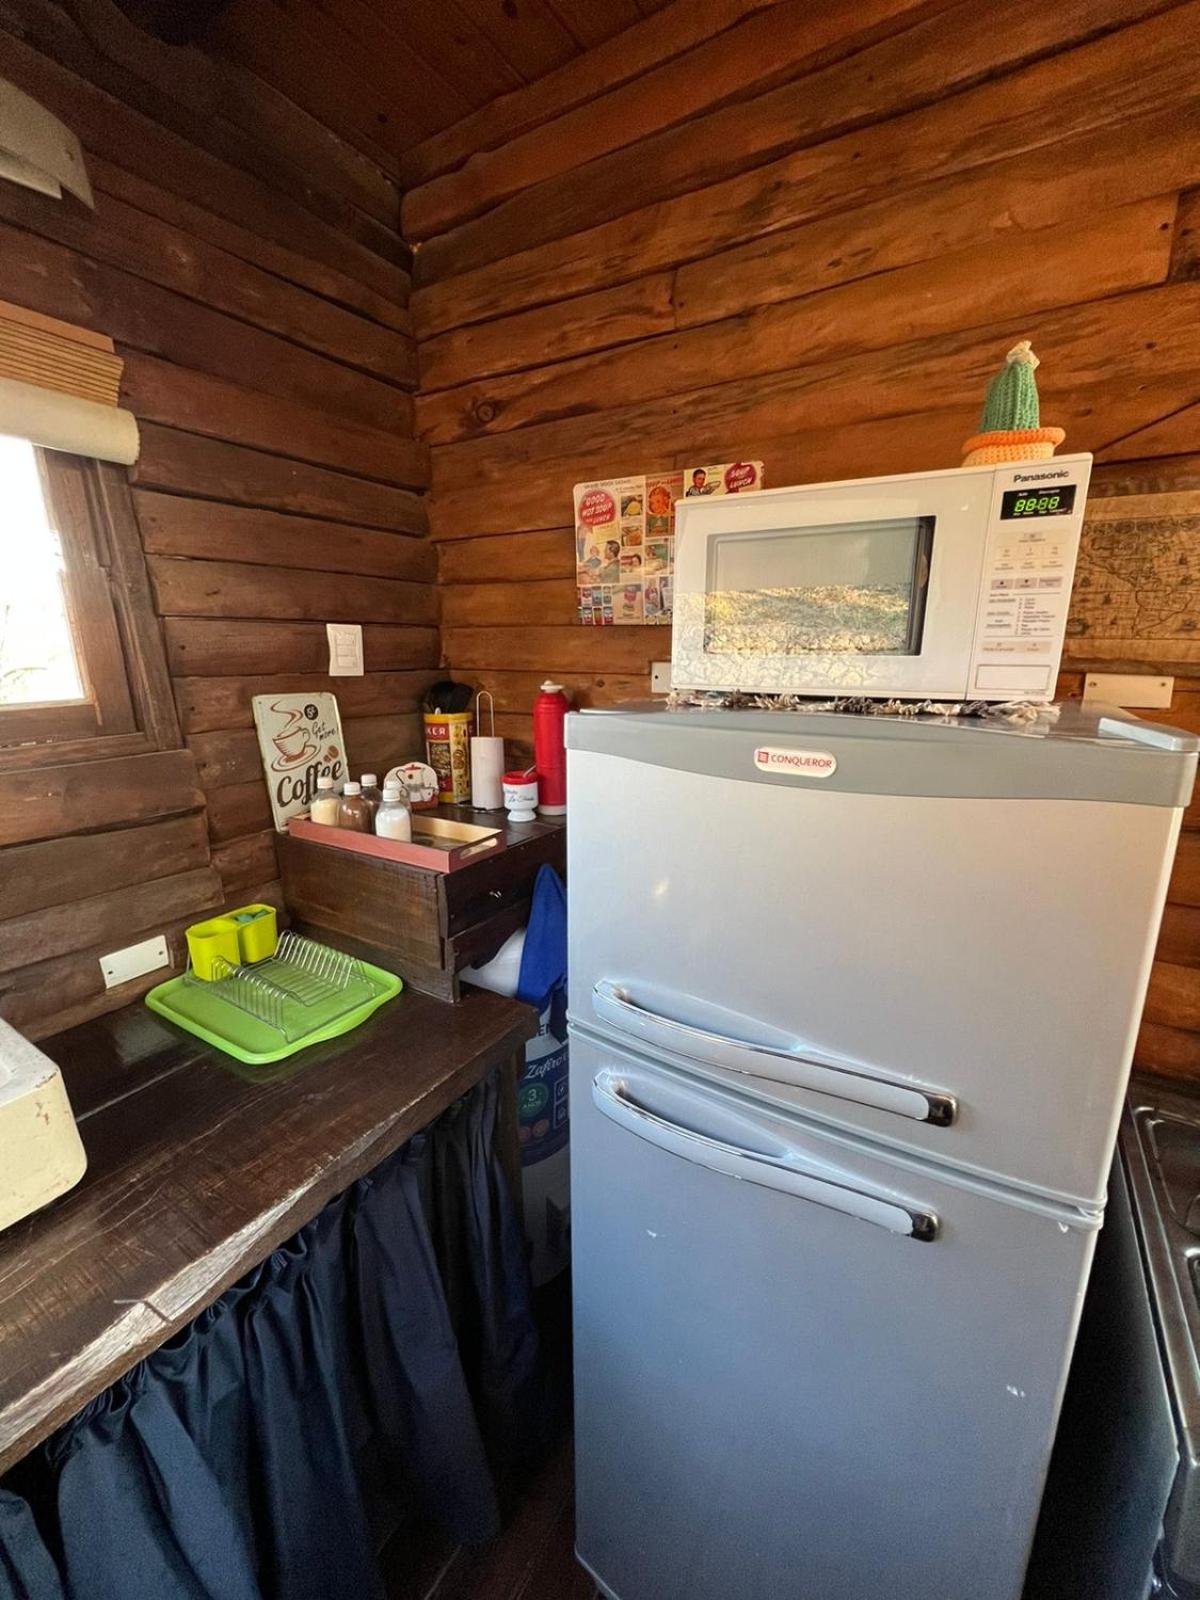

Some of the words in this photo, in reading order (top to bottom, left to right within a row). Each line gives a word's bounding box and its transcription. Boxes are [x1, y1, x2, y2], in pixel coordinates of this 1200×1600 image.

[1013, 470, 1069, 482] Panasonic
[312, 721, 326, 738] Get
[771, 754, 832, 768] CONQUEROR
[277, 761, 344, 807] Coffee
[528, 1088, 537, 1101] 3
